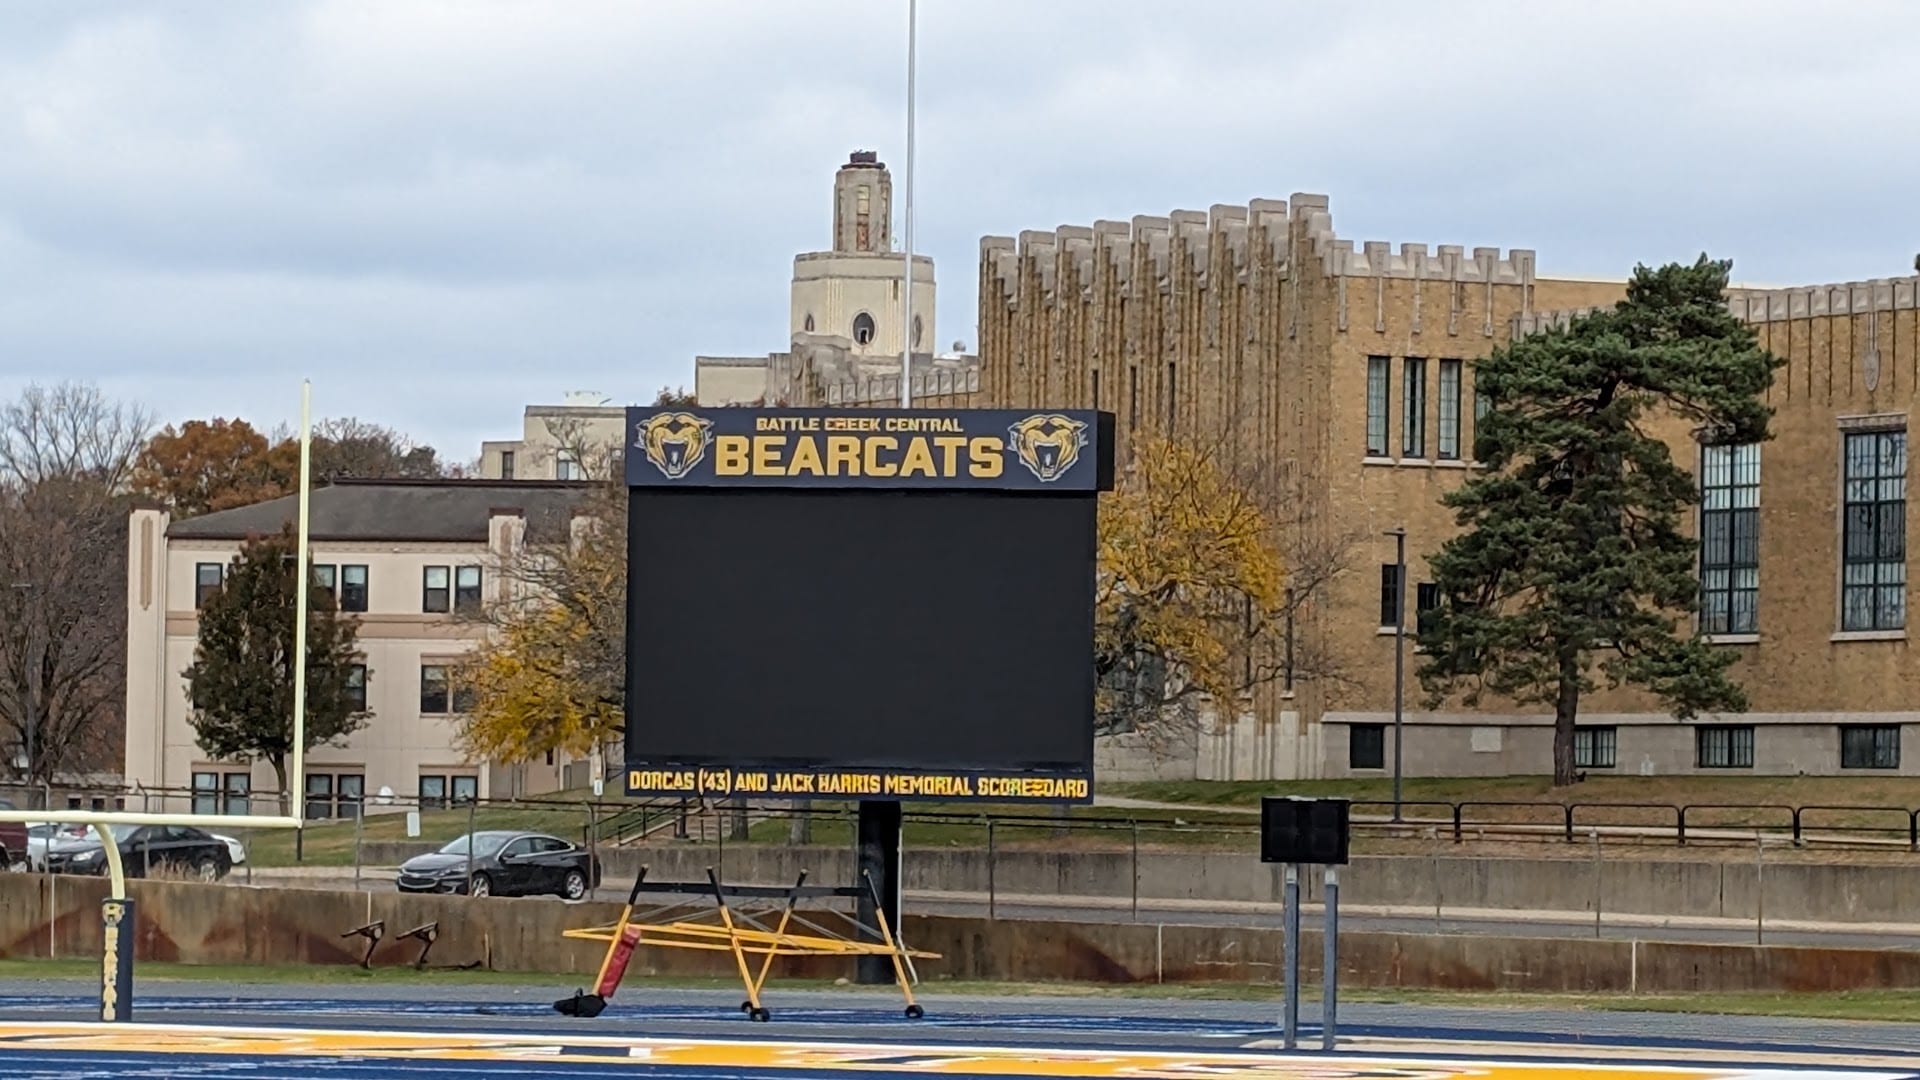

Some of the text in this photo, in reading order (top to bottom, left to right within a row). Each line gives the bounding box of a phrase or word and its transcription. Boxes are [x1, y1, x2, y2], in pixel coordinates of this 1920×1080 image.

[757, 417, 964, 432] BATTLE CREEK CENTRAL
[716, 435, 1003, 477] BEARCATS
[629, 771, 694, 790] DORCAS
[698, 768, 731, 796] ('43)
[734, 773, 768, 792] AND
[771, 774, 815, 793] JACK
[817, 774, 881, 794] HARRIS
[884, 775, 973, 796] MEMORIAL
